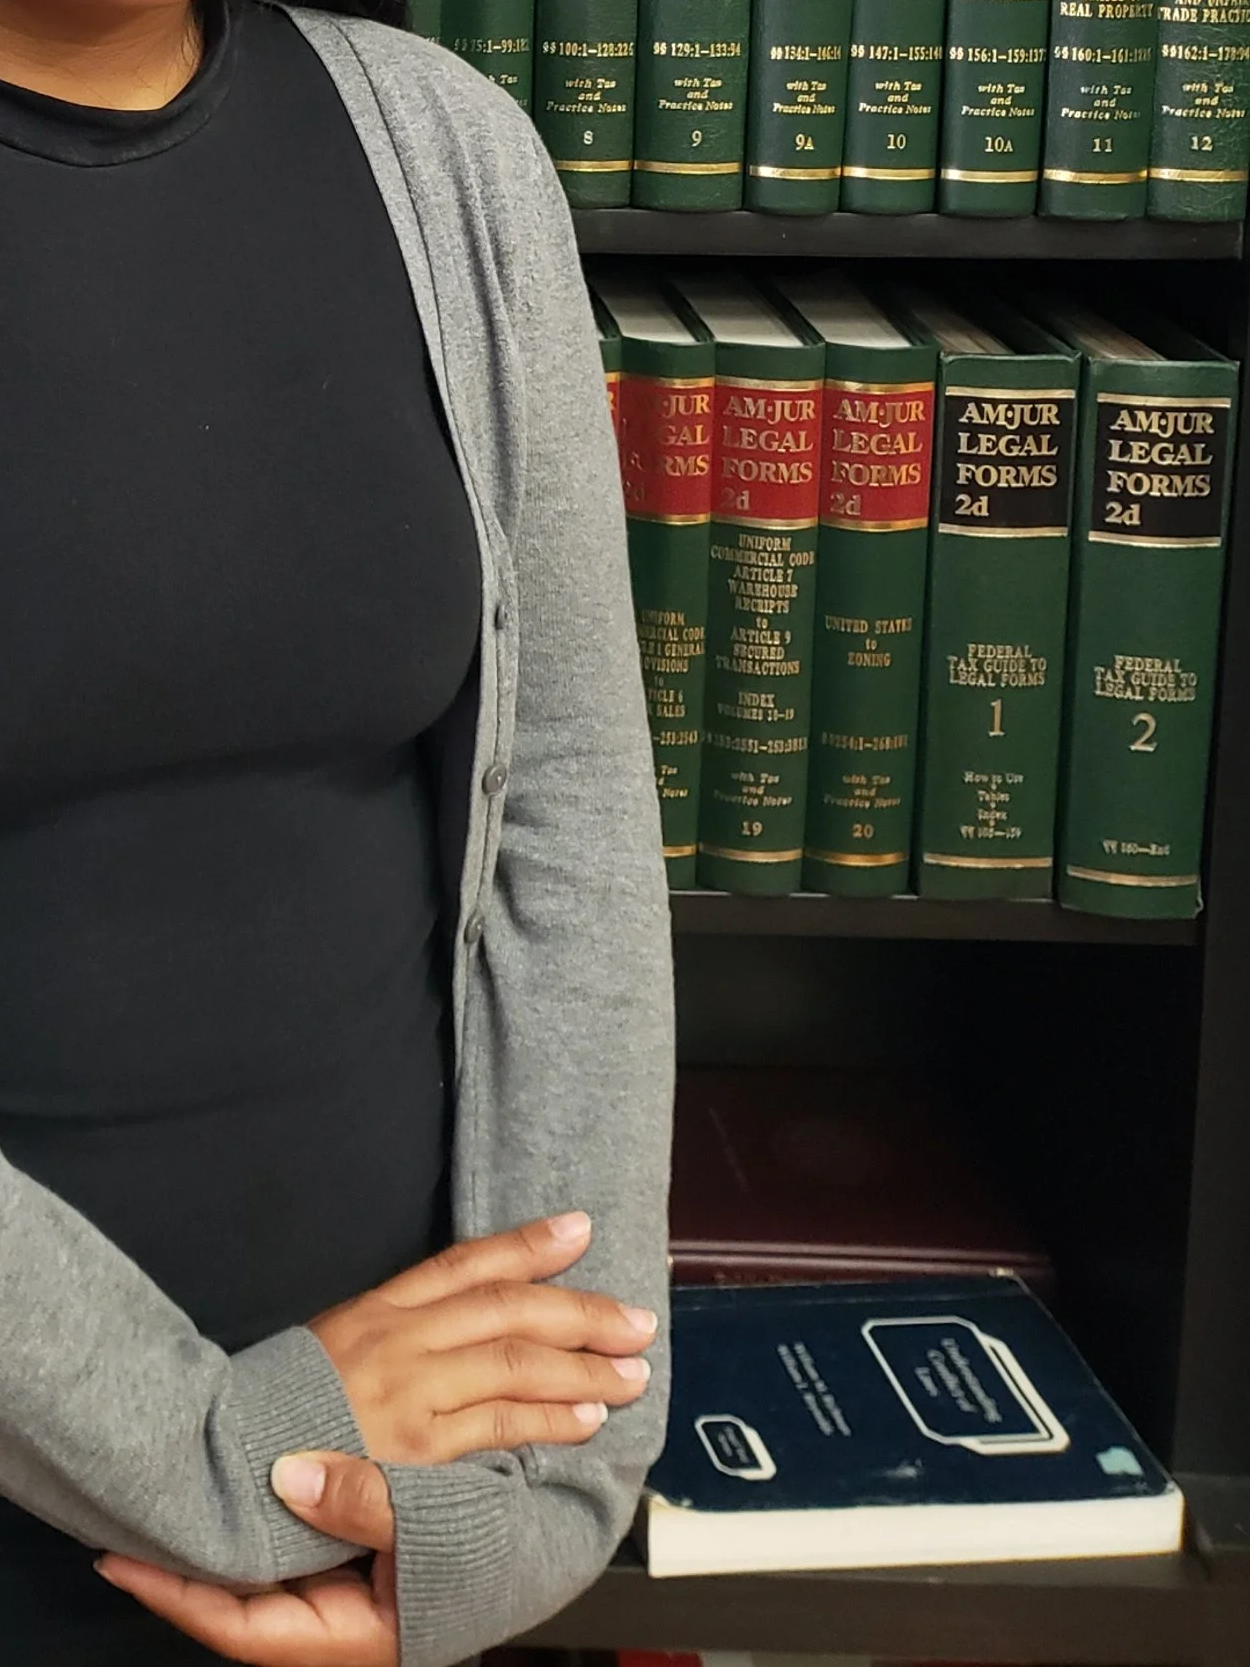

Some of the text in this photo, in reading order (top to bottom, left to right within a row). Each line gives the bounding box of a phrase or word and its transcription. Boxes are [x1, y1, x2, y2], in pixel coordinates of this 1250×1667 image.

[692, 131, 701, 146] 9
[796, 134, 814, 150] 9A
[887, 134, 905, 149] 10
[985, 137, 1012, 152] 10A
[1093, 139, 1111, 152] 11
[1192, 136, 1212, 150] 12
[958, 432, 1058, 456] LEGAL
[1109, 440, 1212, 465] LEGAL
[957, 463, 1056, 487] FORMS
[1107, 471, 1210, 496] FORMS
[955, 494, 988, 516] 2d
[1105, 502, 1140, 525] 2d
[848, 652, 890, 666] ZONING
[967, 644, 1033, 659] FEDERAL
[989, 700, 1004, 736] 1
[1130, 714, 1156, 751] 2
[853, 824, 873, 837] 20
